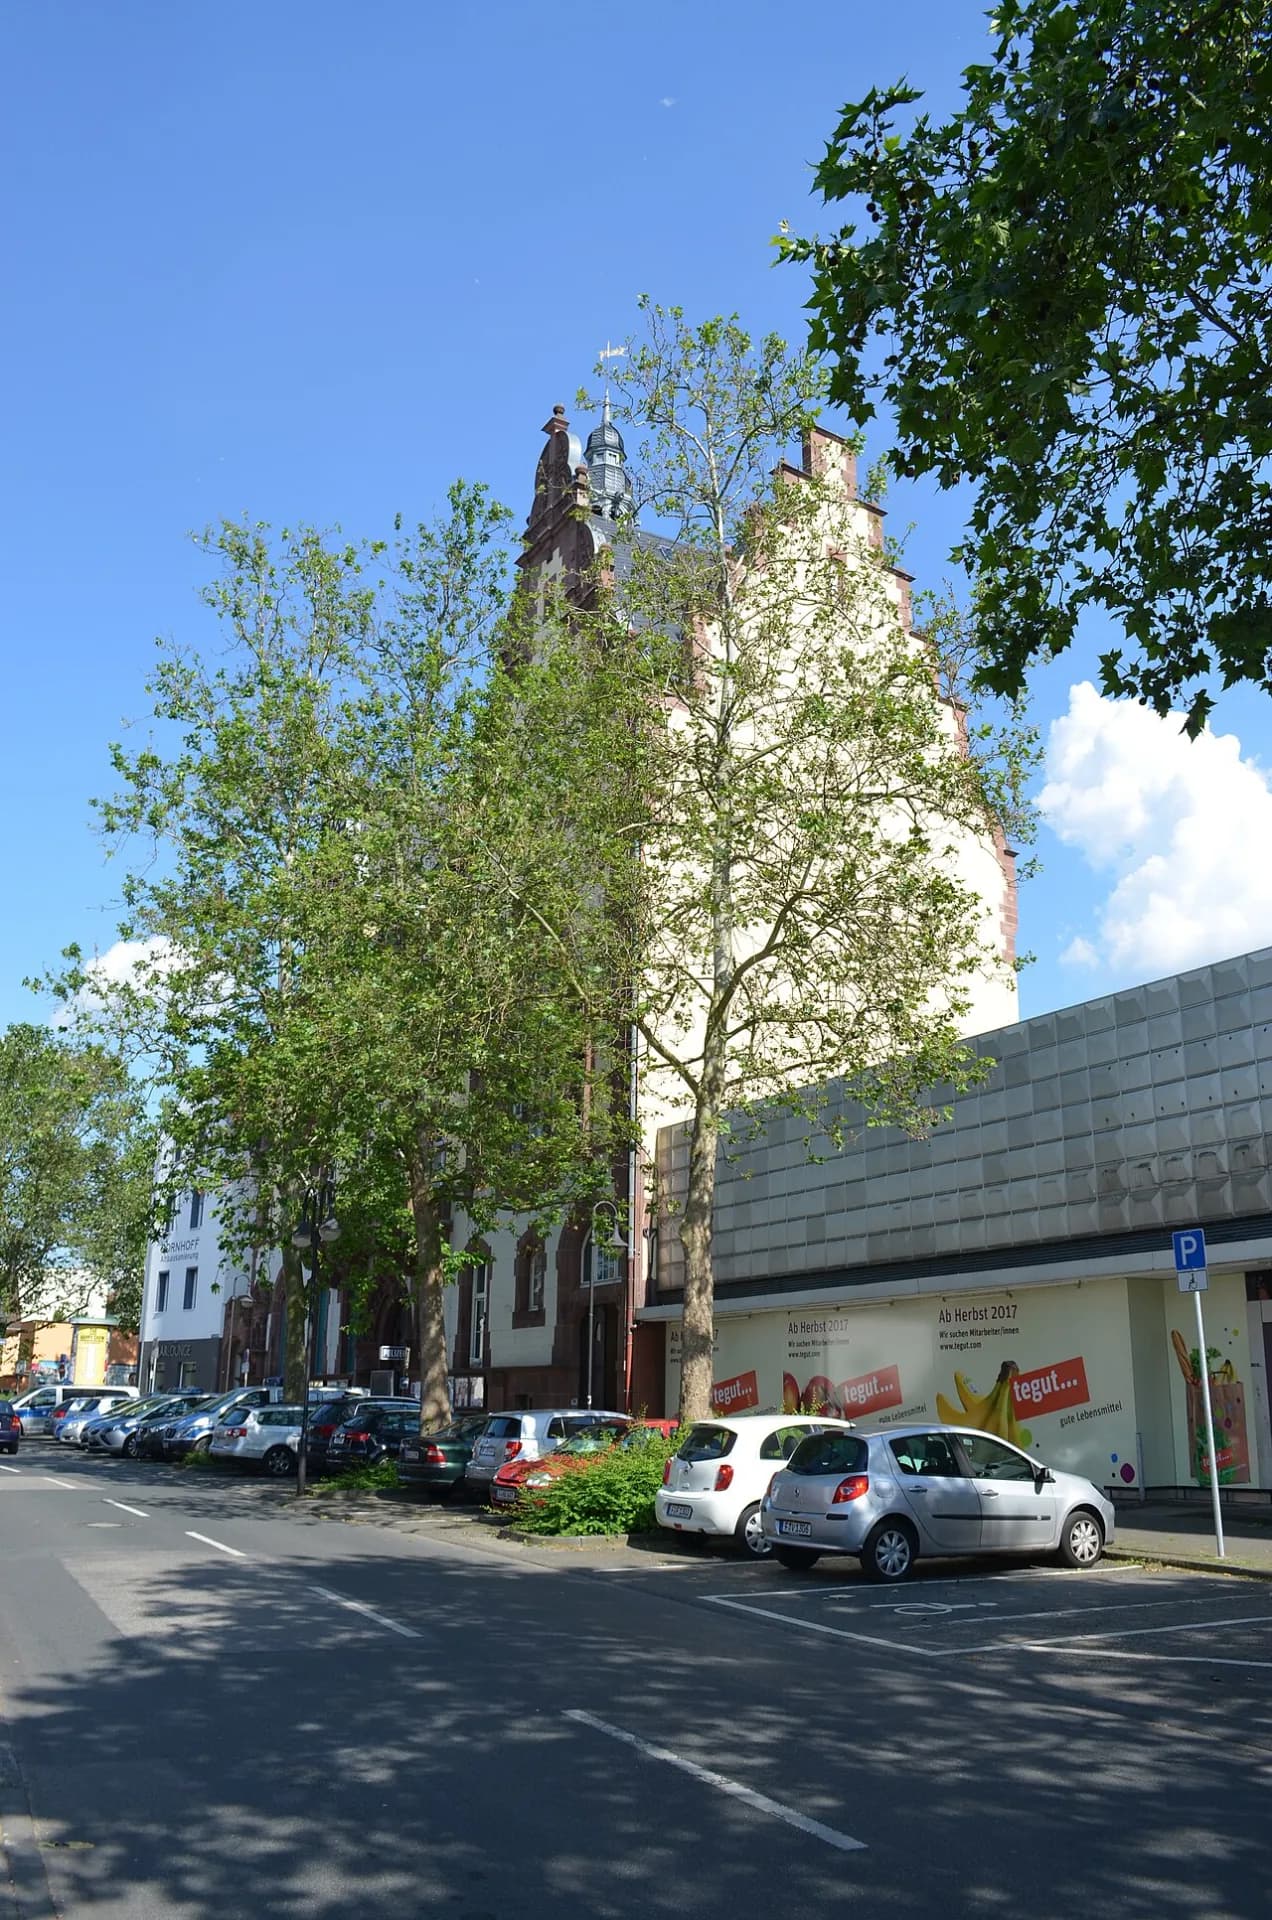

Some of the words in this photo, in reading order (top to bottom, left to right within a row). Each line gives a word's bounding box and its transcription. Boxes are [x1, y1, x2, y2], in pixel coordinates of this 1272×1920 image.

[1180, 1236, 1198, 1266] P
[938, 1309, 952, 1323] Ab
[955, 1306, 989, 1322] Herbst
[991, 1304, 1018, 1320] 2017
[788, 1321, 799, 1334] Ab
[800, 1319, 826, 1334] Herbst
[828, 1319, 849, 1332] 2017
[939, 1330, 949, 1339] Wir
[949, 1328, 969, 1338] suchen
[969, 1325, 1020, 1337] Mitarbeiter/innen
[939, 1341, 982, 1351] www.tegut.com
[713, 1380, 752, 1405] tegut...
[844, 1375, 894, 1404] tegut...
[1013, 1369, 1078, 1403] tegut...
[1060, 1411, 1076, 1428] gute
[1076, 1400, 1123, 1421] Lebensmittel
